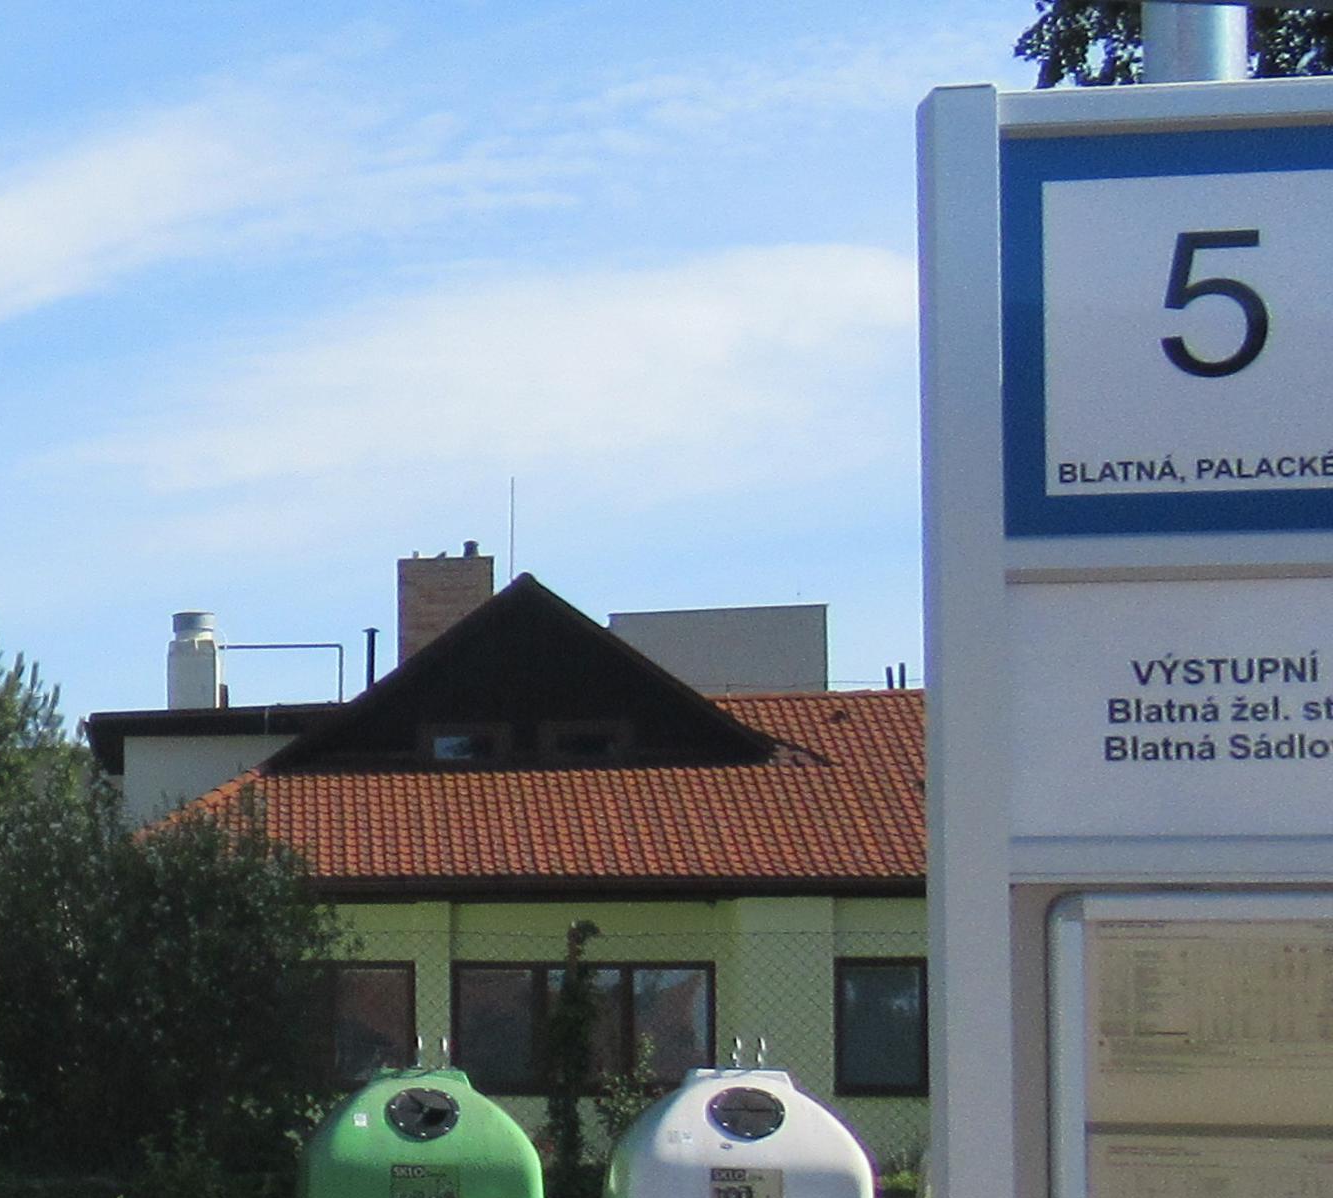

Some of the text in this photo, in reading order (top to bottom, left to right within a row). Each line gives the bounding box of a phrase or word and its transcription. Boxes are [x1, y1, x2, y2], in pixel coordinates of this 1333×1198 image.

[1161, 229, 1270, 378] 5
[1058, 453, 1186, 484] BLATNÁ,
[1131, 650, 1318, 686] VÝSTUPNÍ
[1108, 696, 1220, 723] Blatná
[1231, 696, 1290, 722] žel.
[1104, 733, 1333, 762] Blatná Sádlo
